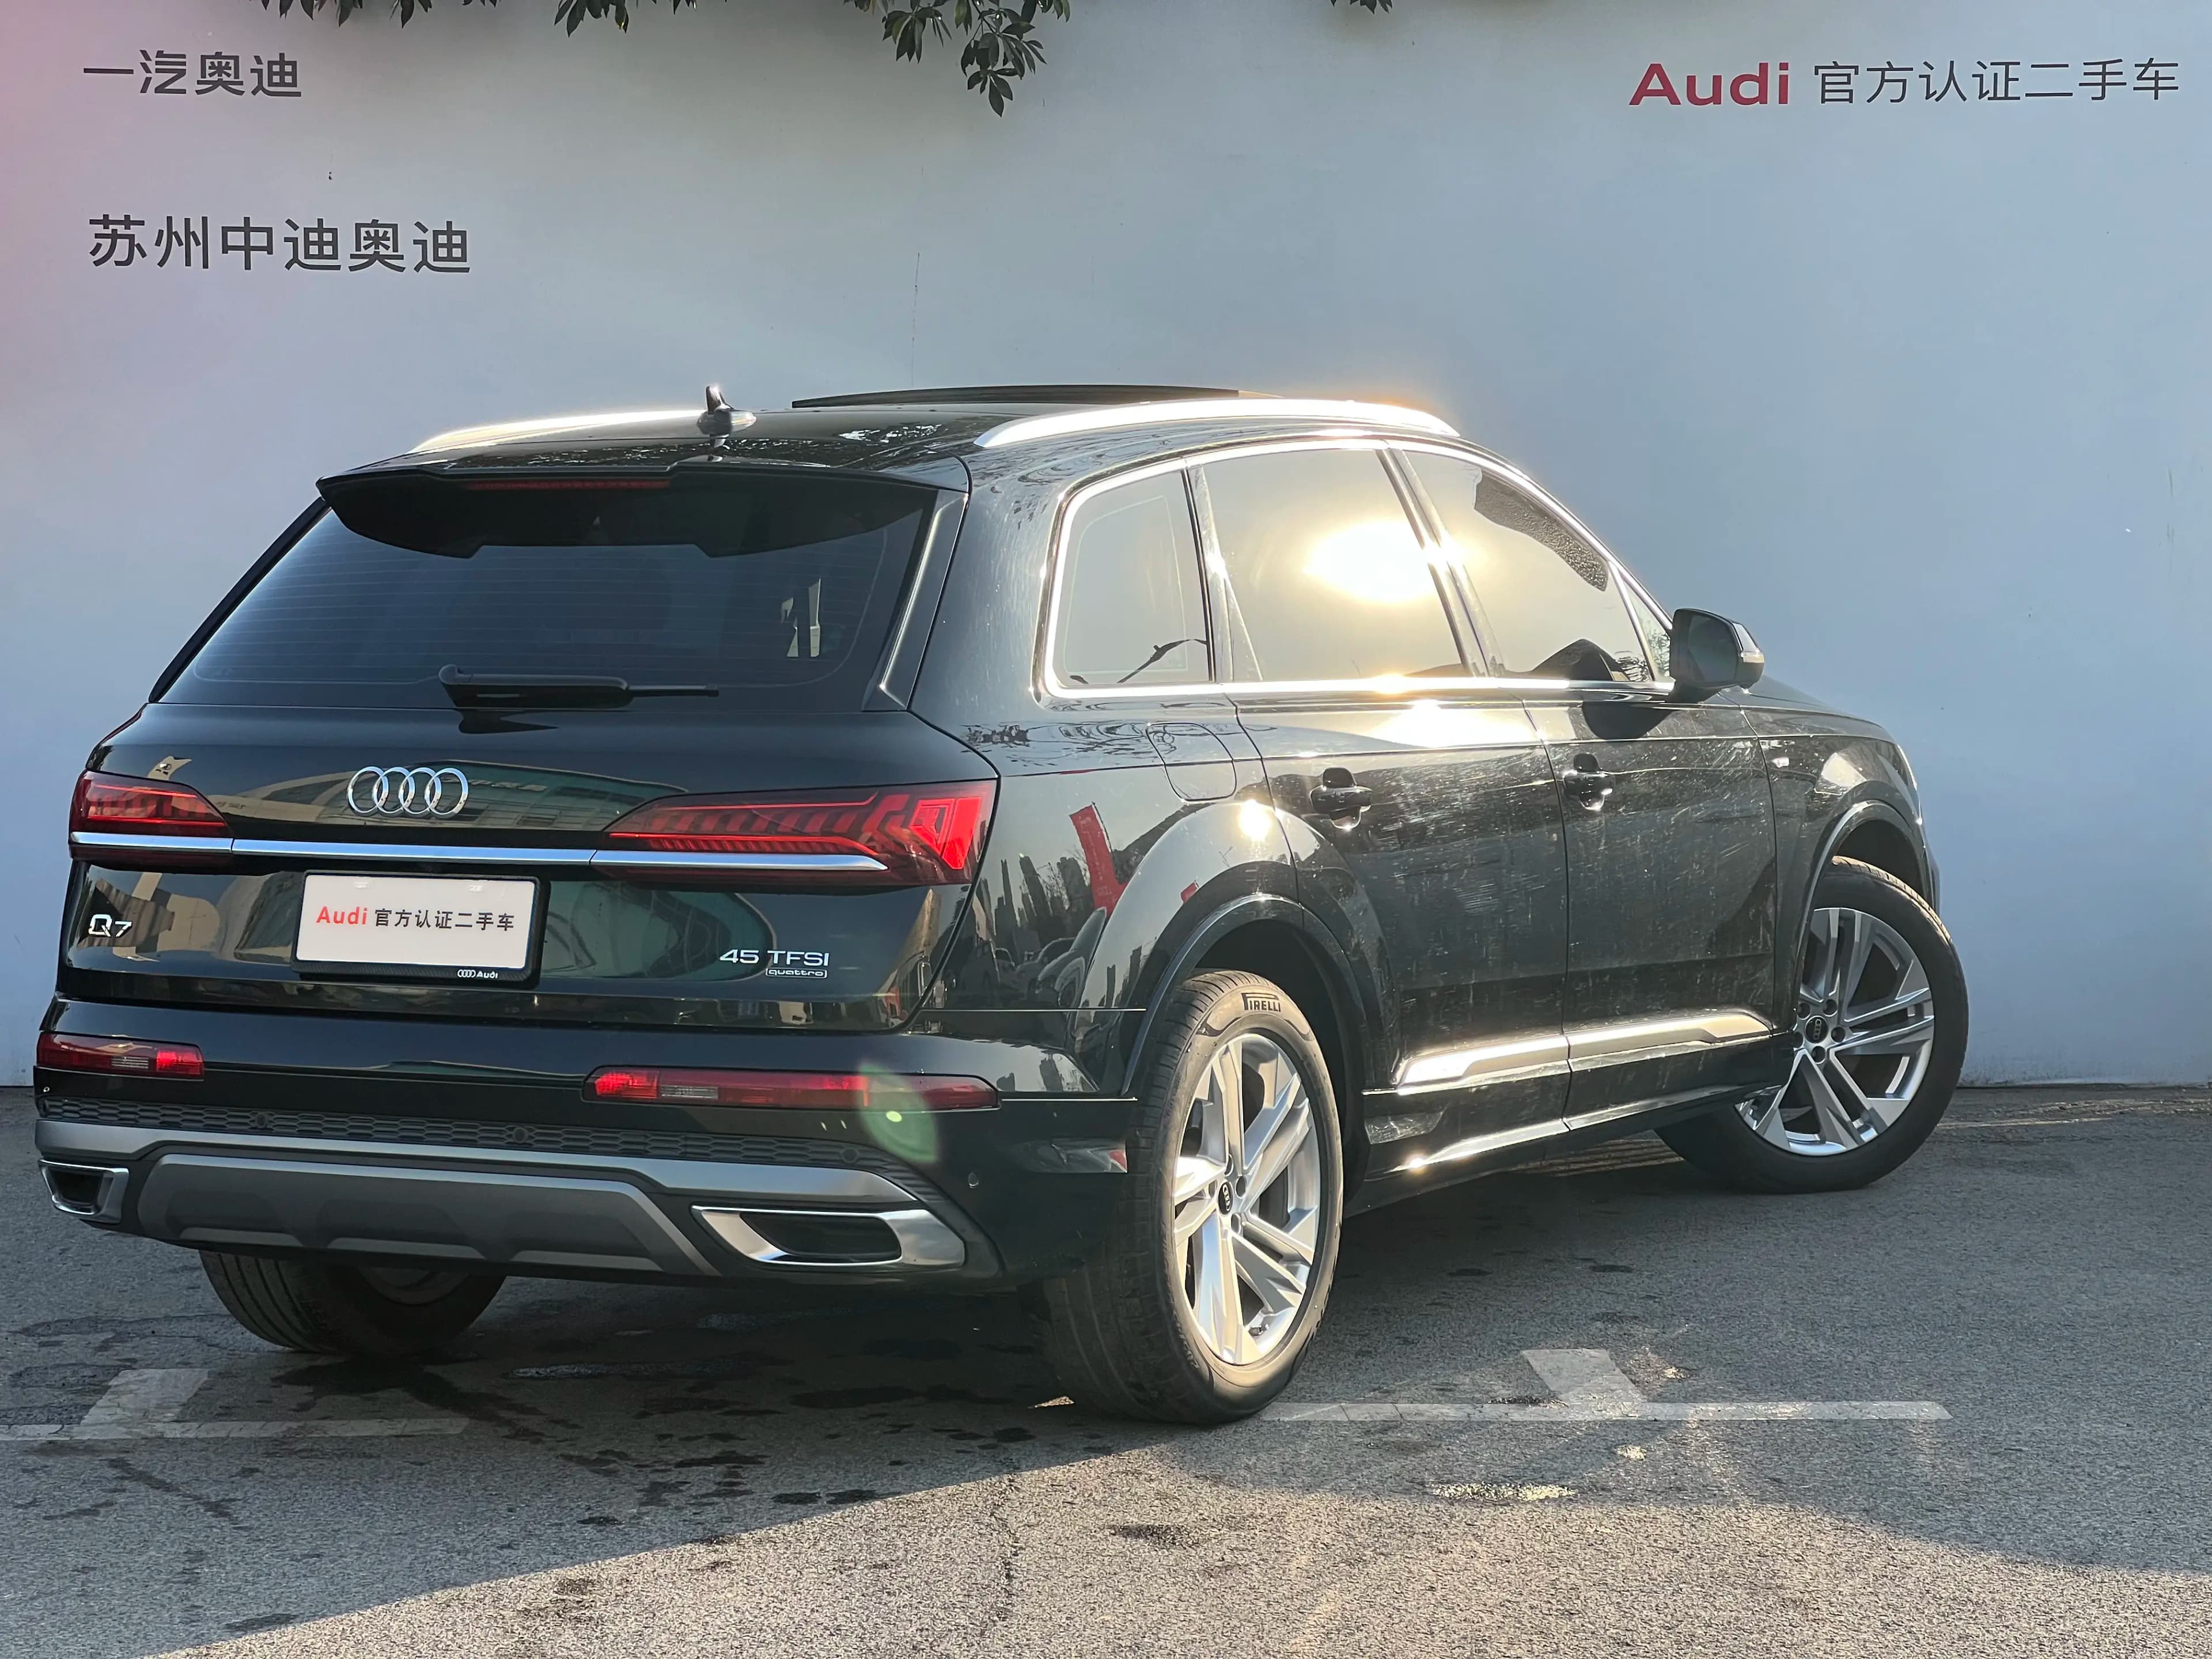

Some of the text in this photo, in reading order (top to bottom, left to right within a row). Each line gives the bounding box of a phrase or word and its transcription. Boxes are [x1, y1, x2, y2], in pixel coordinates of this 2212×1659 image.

[84, 50, 301, 97] 一汽奥迪
[1629, 58, 2180, 105] Audi 官方认证二手车
[89, 214, 470, 273] 苏州中迪奥迪
[88, 914, 132, 937] Q7
[316, 906, 514, 931] Audi 官方认证二手车
[720, 949, 830, 966] 45 TFSI
[476, 971, 498, 979] Audi
[768, 968, 824, 976] quattro
[1241, 993, 1281, 1012] PIRELLI
